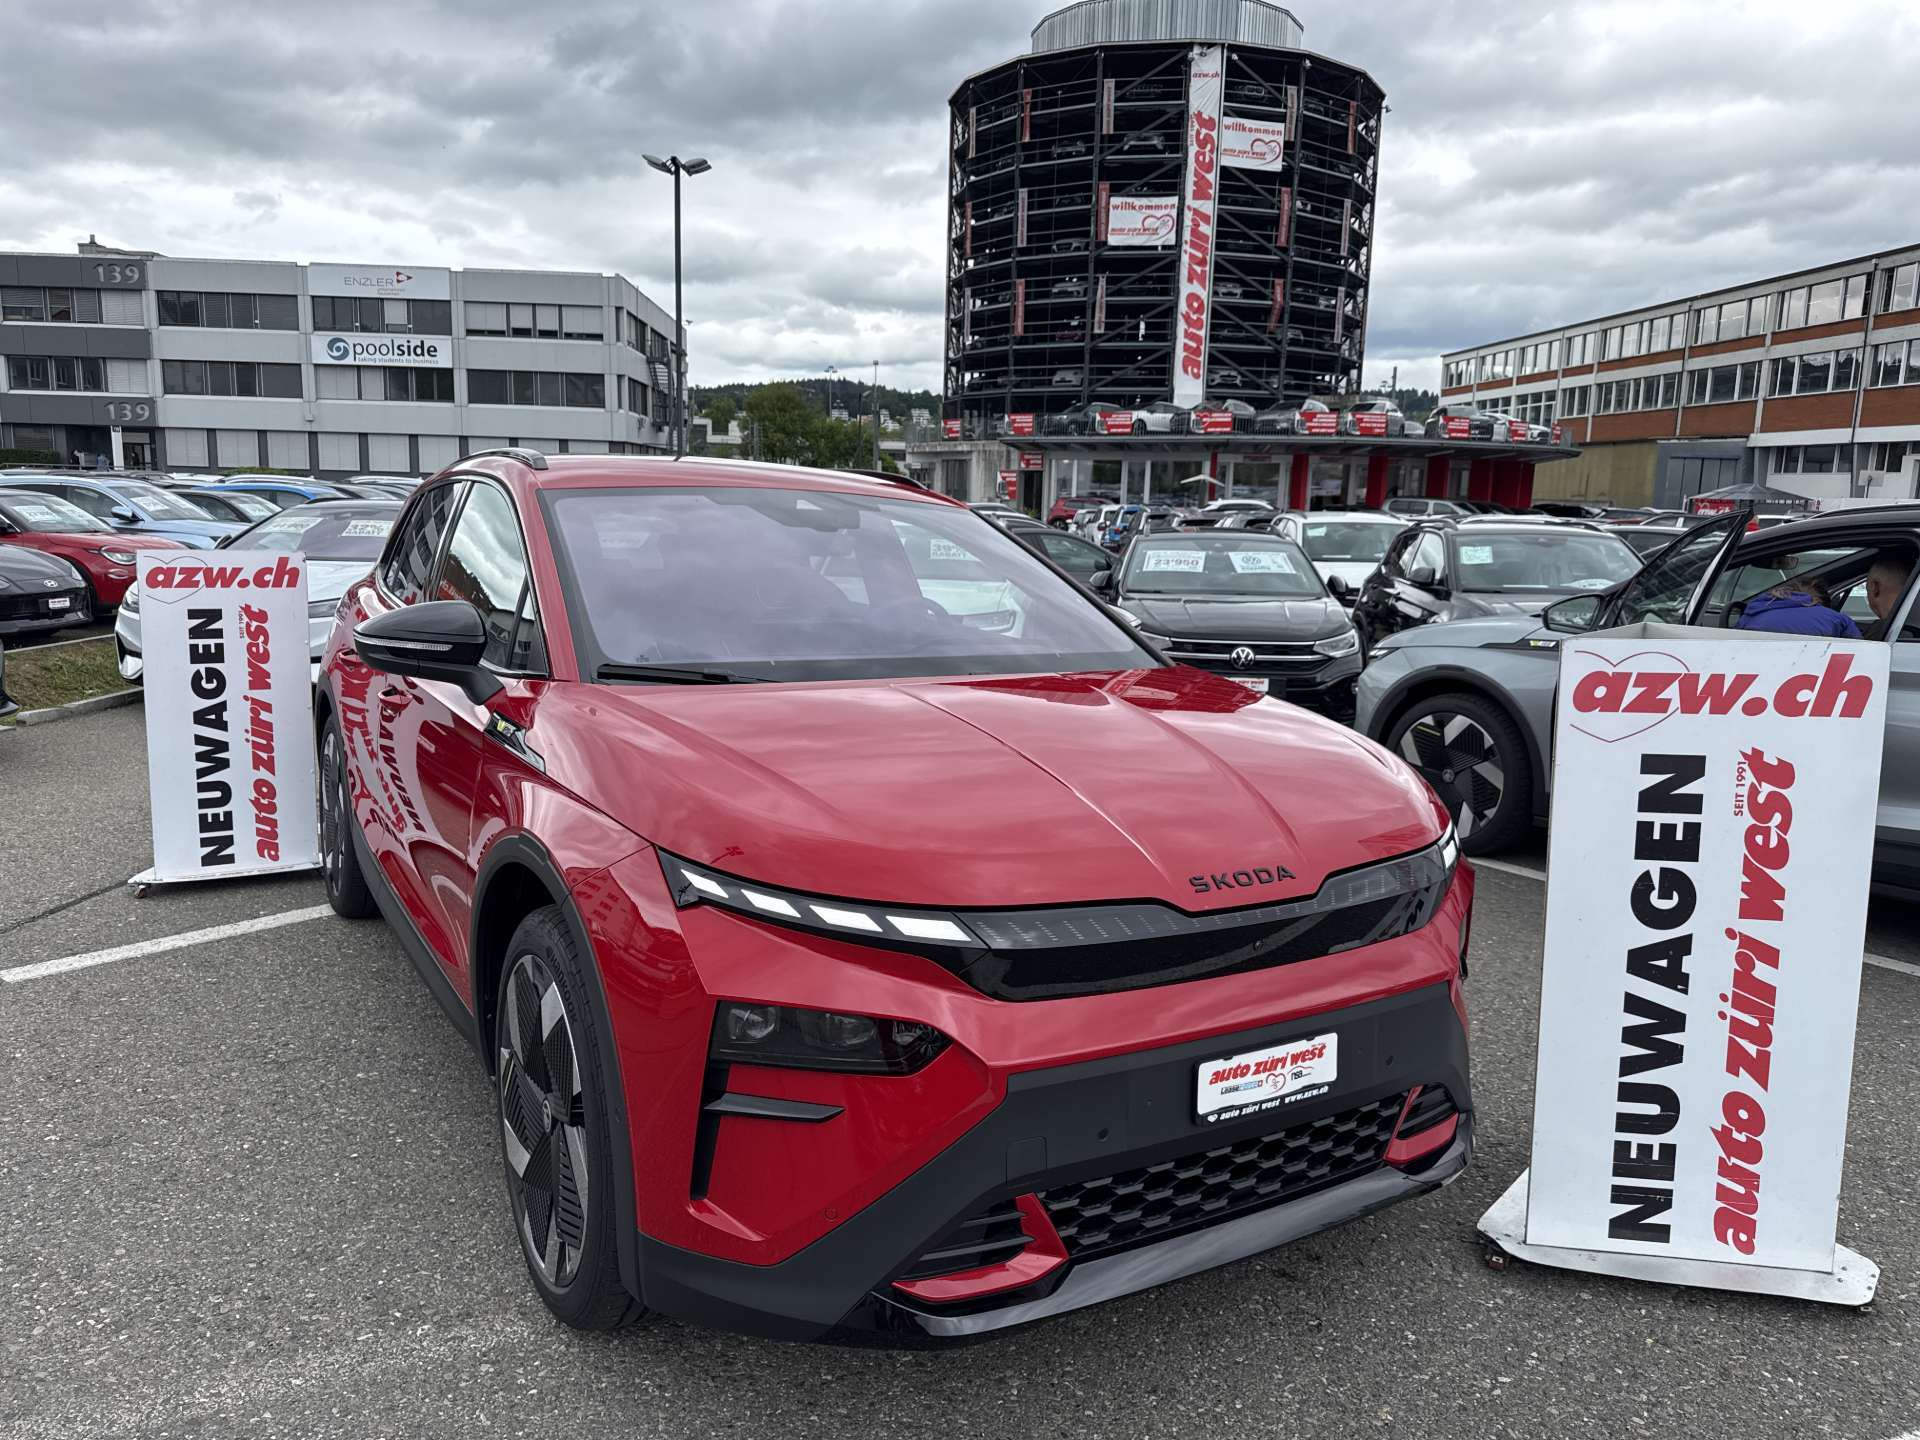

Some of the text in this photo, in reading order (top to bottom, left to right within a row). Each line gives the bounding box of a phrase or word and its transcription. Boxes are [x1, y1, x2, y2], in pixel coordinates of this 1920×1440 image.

[1224, 122, 1283, 136] willkommen
[1111, 202, 1176, 211] willkommen
[1181, 110, 1217, 380] auto züri west
[94, 264, 140, 284] 139
[344, 277, 394, 287] ENZLER
[353, 339, 438, 362] poolside
[105, 402, 150, 421] 139
[145, 557, 301, 589] azw.ch
[1572, 653, 1873, 719] azw.ch
[187, 608, 236, 867] NEUWAGEN
[240, 603, 280, 862] auto züri west
[1734, 760, 1747, 817] SEIT 1991
[1608, 753, 1706, 1243] NEUWAGEN
[1710, 746, 1796, 1255] auto züri west
[1209, 1043, 1327, 1085] auto züri west
[1220, 1085, 1329, 1121] auto züri west www.azw.ch
